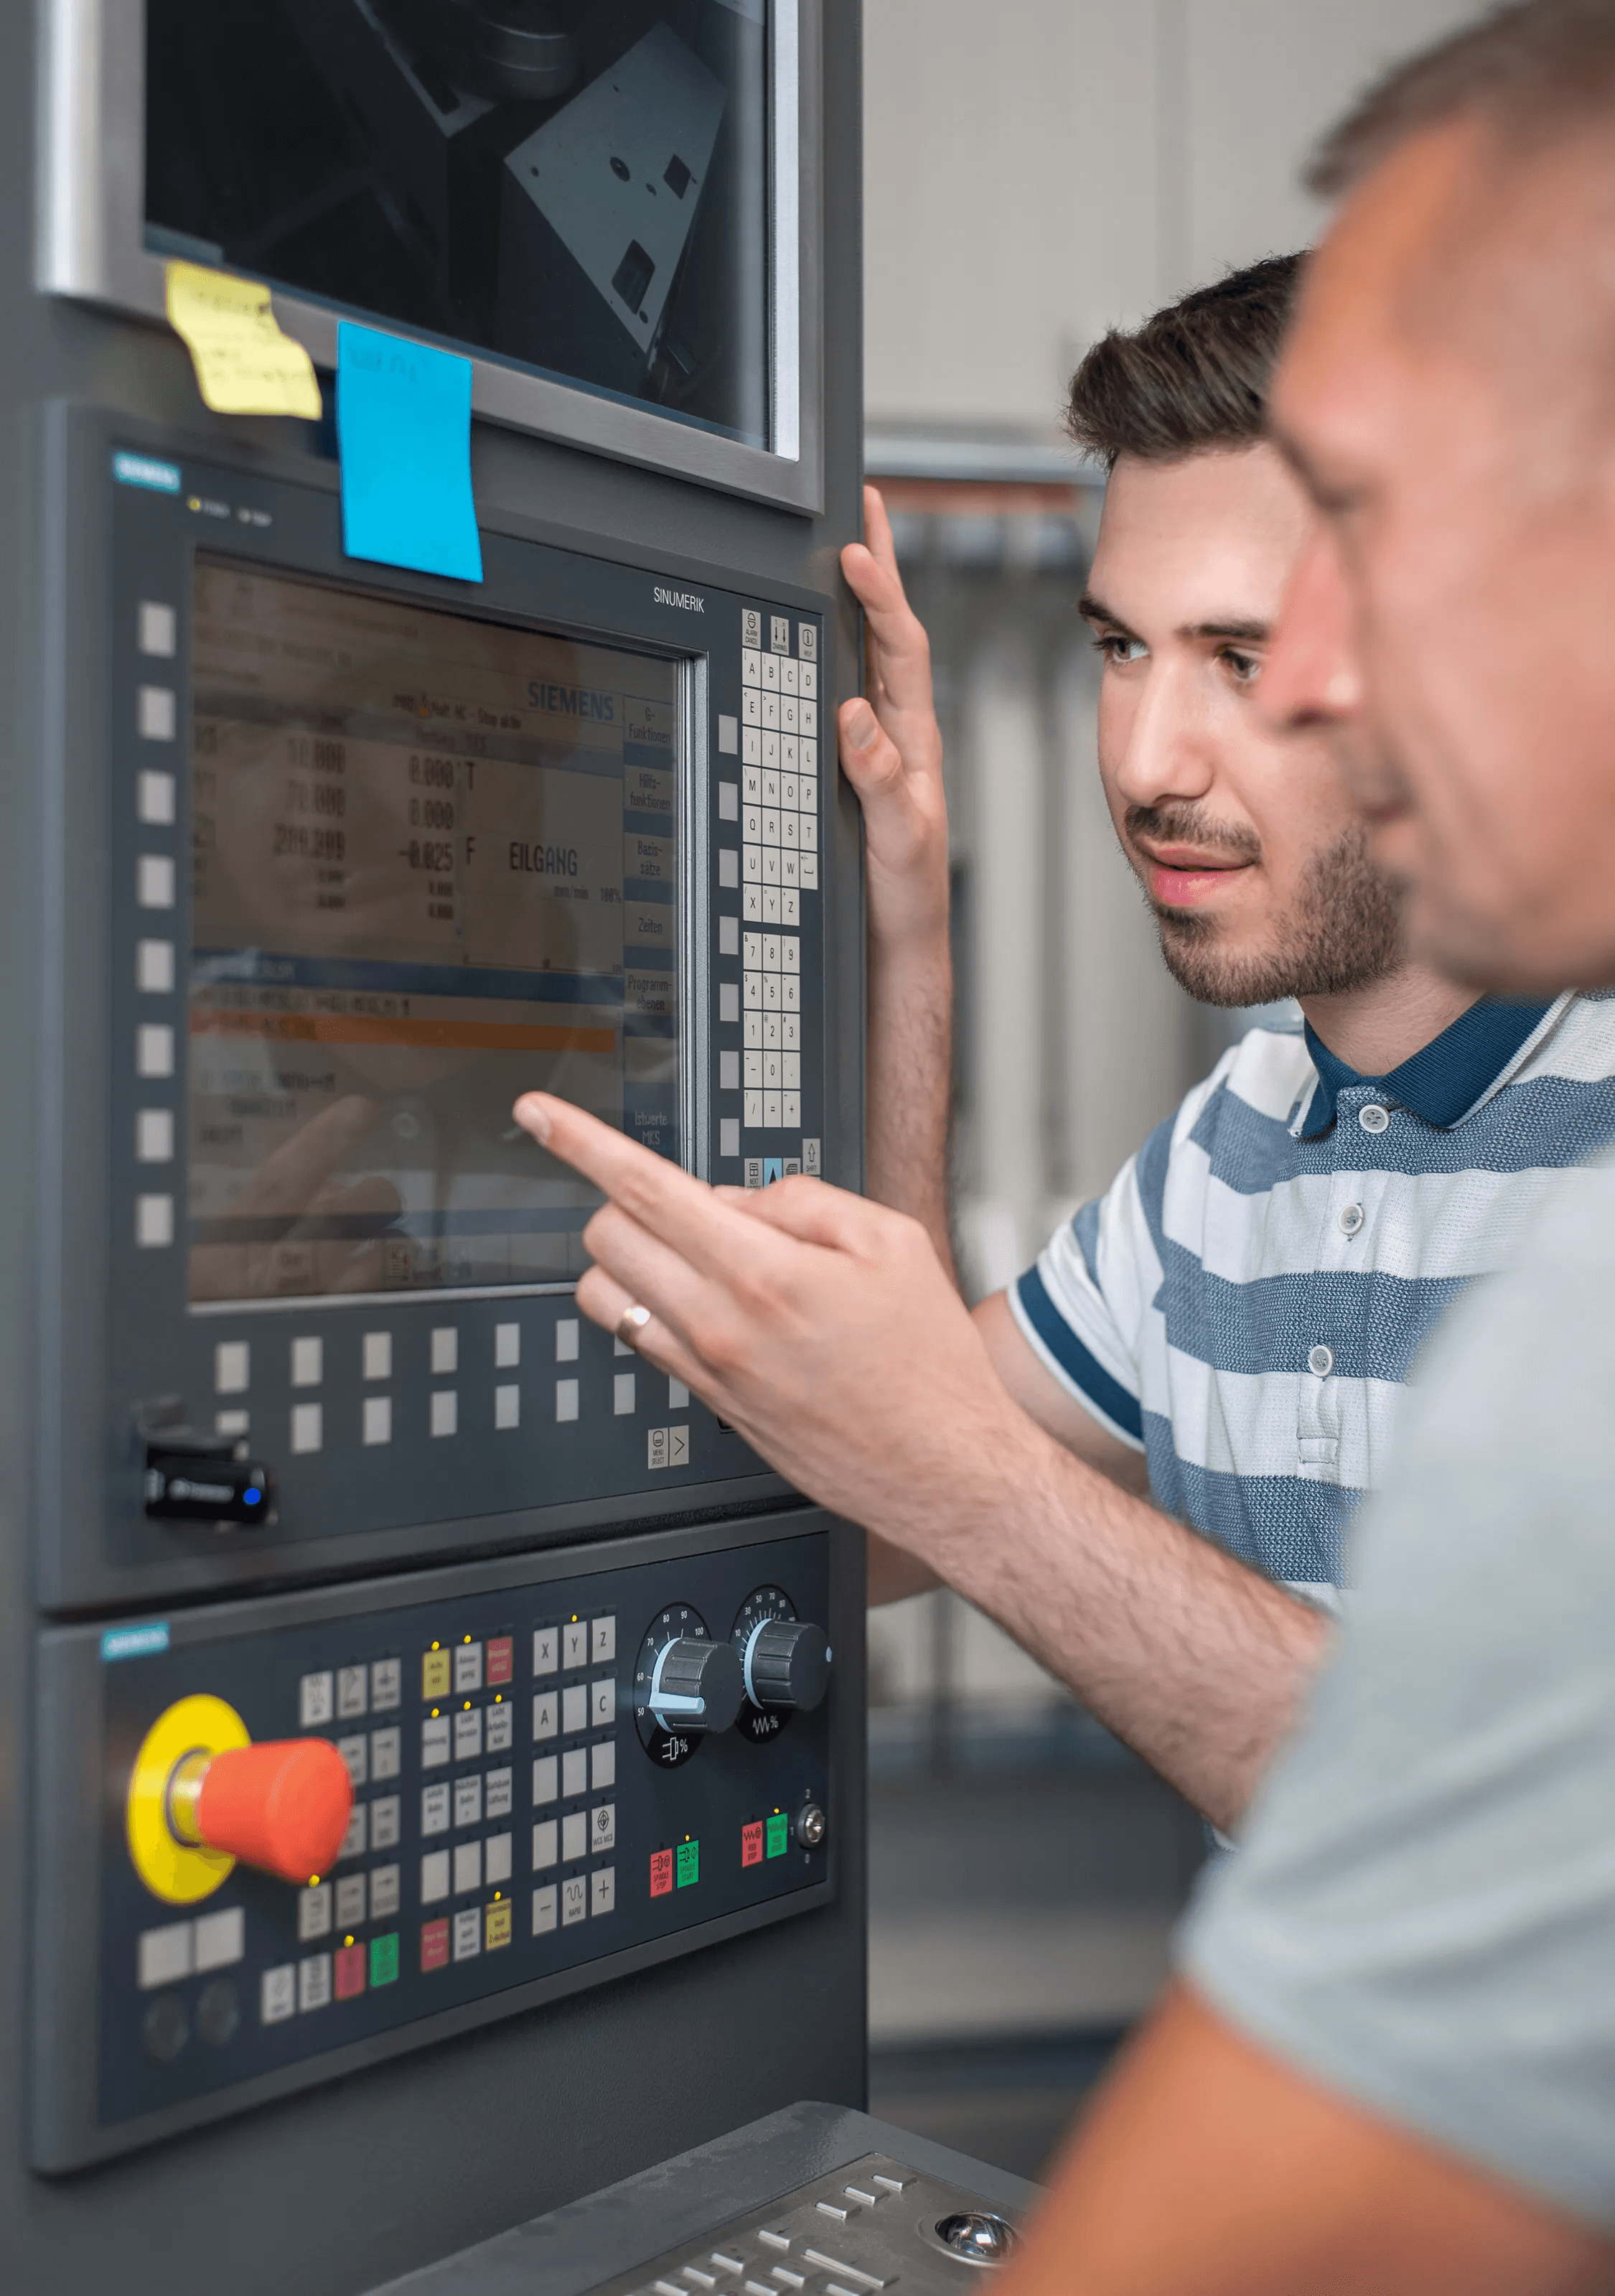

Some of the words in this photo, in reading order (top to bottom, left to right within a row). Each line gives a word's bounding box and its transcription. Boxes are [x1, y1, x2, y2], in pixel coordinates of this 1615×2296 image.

[654, 587, 705, 613] SINUMERIK
[749, 663, 755, 674] A
[769, 666, 774, 678] B
[787, 671, 793, 683] C
[805, 674, 811, 686] D
[528, 681, 614, 721] SIEMENS
[750, 701, 754, 714] E
[769, 705, 774, 717] F
[787, 709, 793, 721] G
[806, 713, 811, 723] H
[629, 724, 670, 743] Funktionen
[751, 740, 754, 752] I
[769, 745, 774, 756] J
[787, 747, 793, 759] K
[806, 751, 811, 762] L
[639, 773, 660, 790] Hilfs-
[749, 779, 756, 791] M
[769, 783, 774, 795] N
[787, 785, 794, 798] O
[806, 788, 811, 800] P
[629, 791, 670, 811] funktionen
[749, 818, 756, 831] Q
[769, 821, 774, 833] R
[788, 823, 793, 836] S
[806, 826, 811, 837] T
[637, 840, 663, 857] Basis-
[509, 841, 579, 877] EILGANG
[750, 858, 756, 870] U
[769, 860, 775, 872] V
[787, 862, 795, 874] W
[750, 897, 756, 909] X
[769, 899, 775, 910] Y
[788, 901, 794, 913] Z
[638, 918, 663, 934] Zeiten
[750, 946, 755, 957] 7
[769, 947, 774, 959] 8
[788, 948, 794, 961] 9
[628, 974, 673, 993] Programm-
[751, 985, 756, 997] 4
[770, 986, 774, 998] 5
[788, 987, 794, 999] 6
[637, 994, 665, 1011] ebenen
[752, 1025, 755, 1035] 1
[770, 1025, 775, 1037] 2
[789, 1026, 794, 1038] 3
[770, 1064, 775, 1076] 0
[635, 1111, 667, 1126] Istwerte
[642, 1129, 660, 1145] MKS
[652, 1456, 664, 1466] SELECT
[663, 1614, 670, 1623] 80
[680, 1610, 688, 1620] 90
[695, 1626, 704, 1636] 100
[571, 1637, 579, 1653] Y
[600, 1631, 607, 1648] Z
[647, 1637, 654, 1646] 70
[541, 1643, 549, 1659] X
[637, 1671, 645, 1681] 60
[599, 1695, 607, 1712] C
[540, 1709, 549, 1725] A
[637, 1707, 645, 1717] 50
